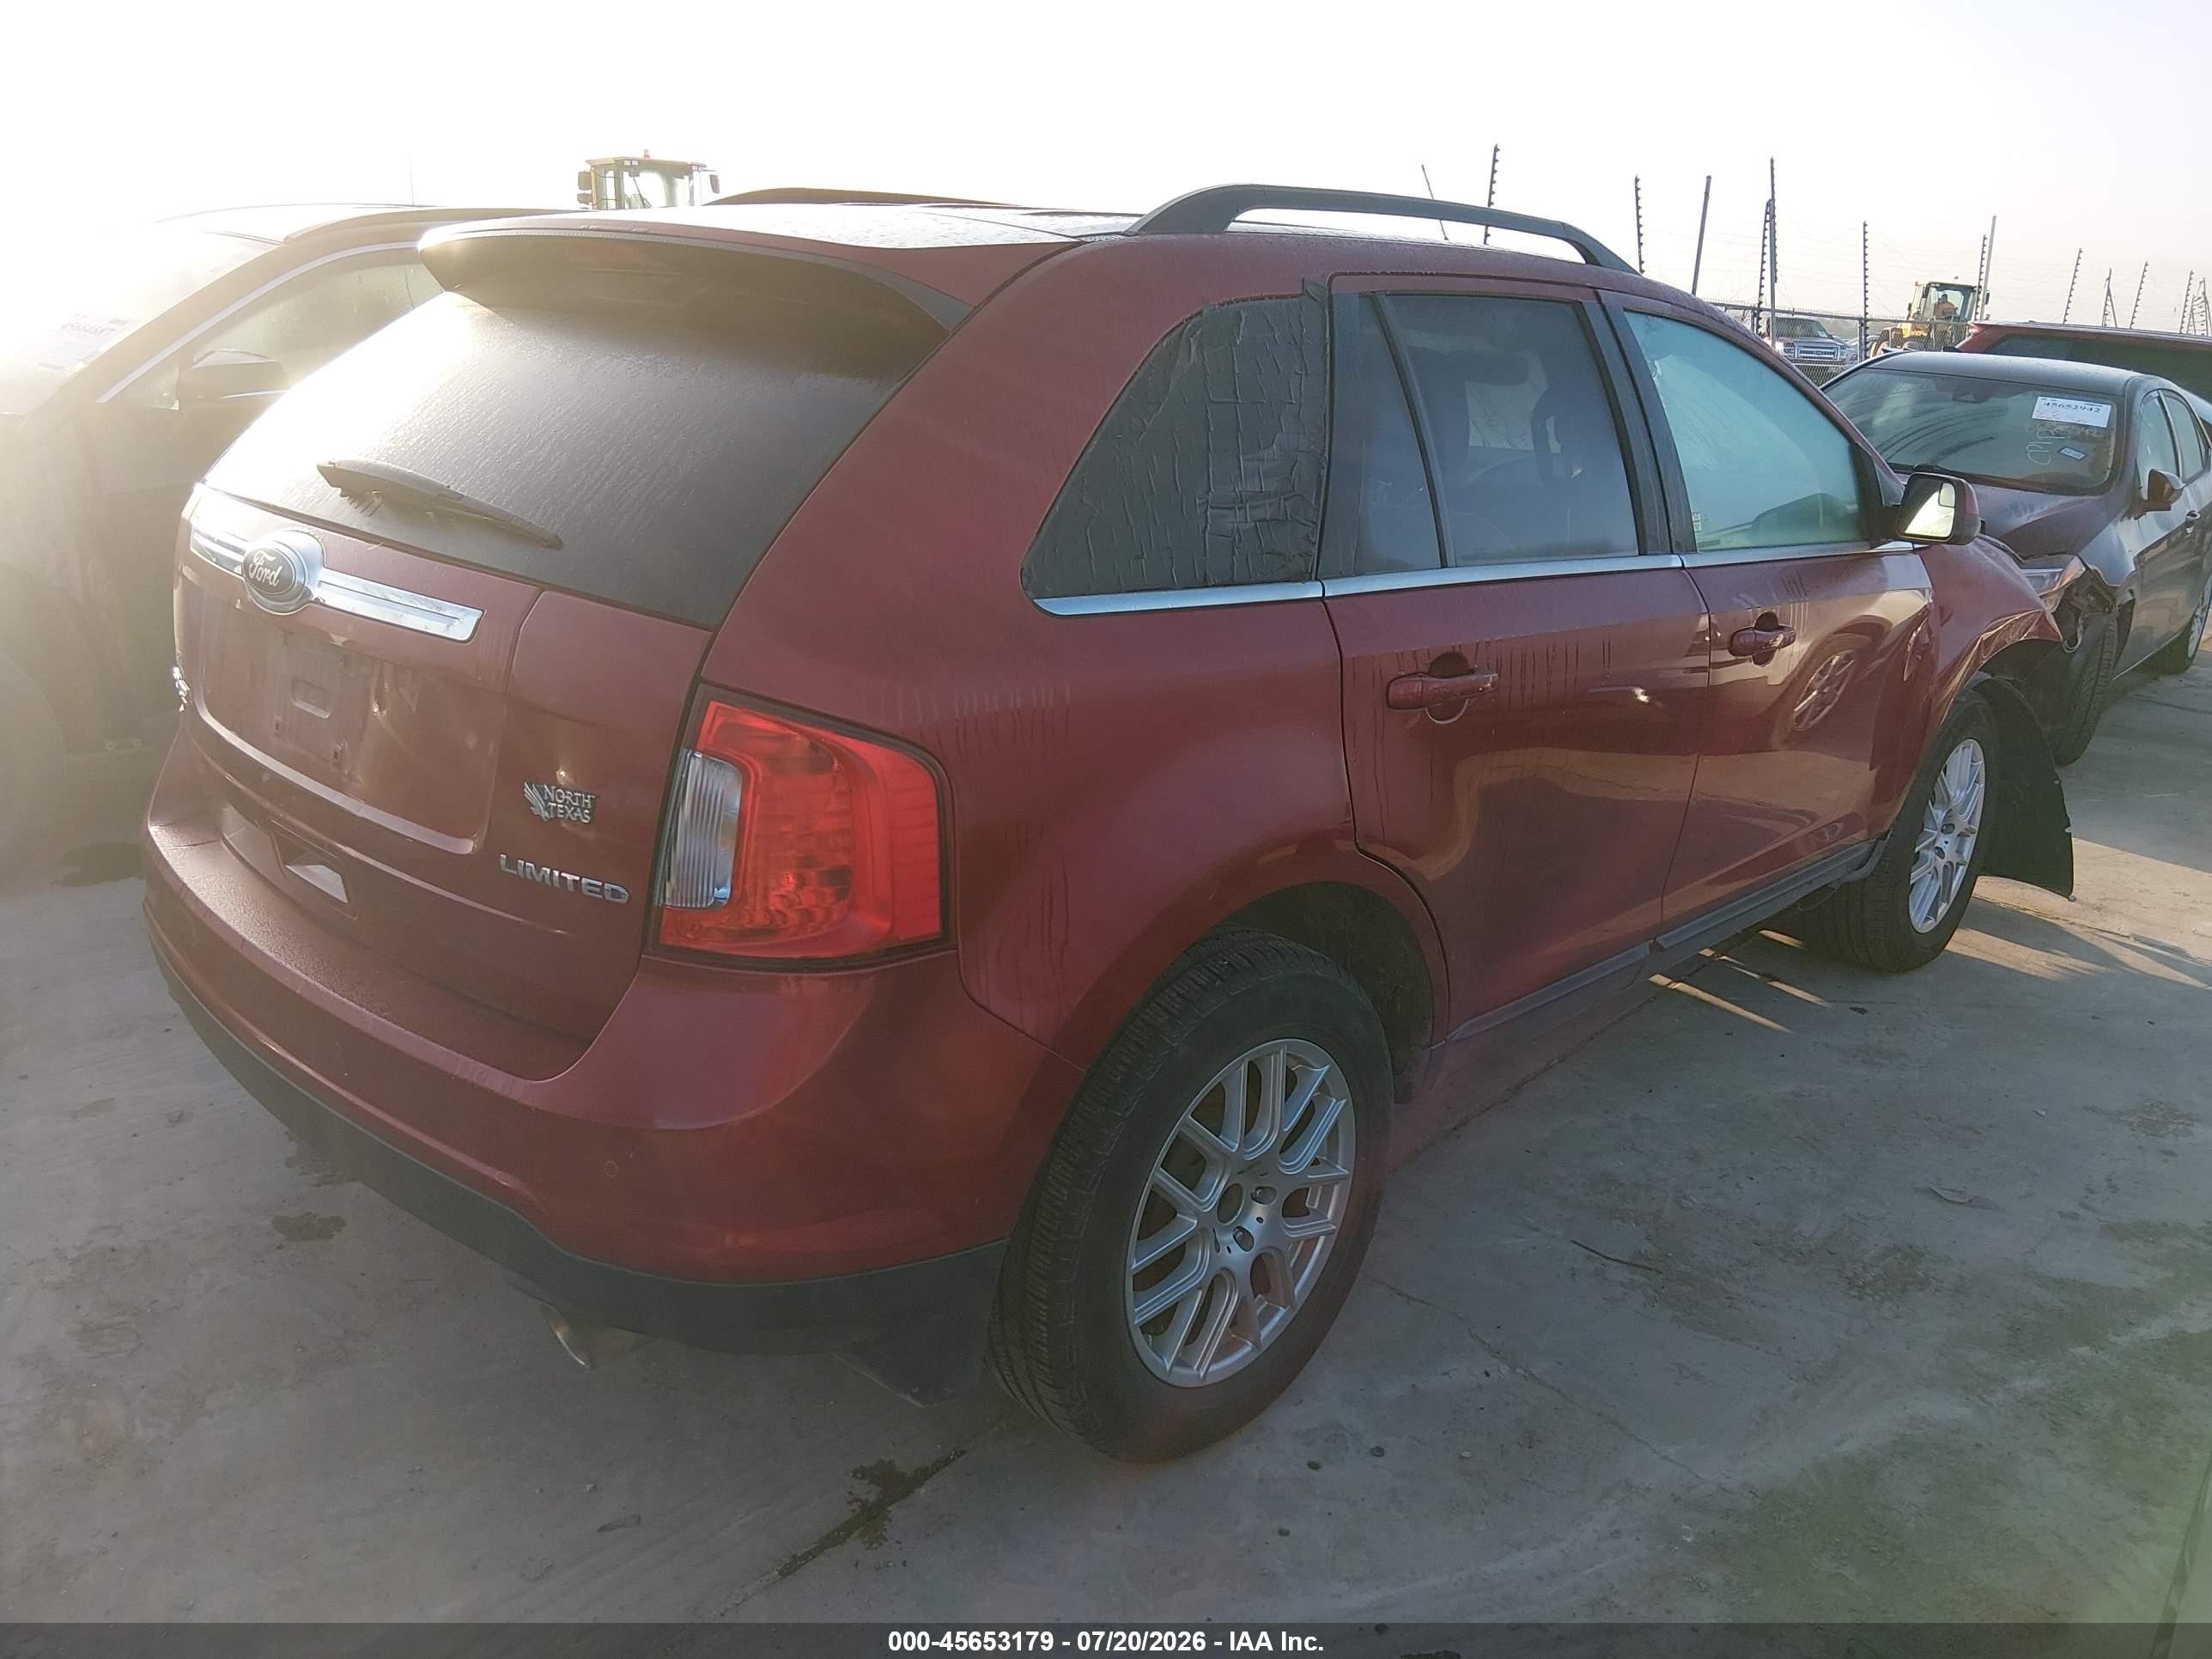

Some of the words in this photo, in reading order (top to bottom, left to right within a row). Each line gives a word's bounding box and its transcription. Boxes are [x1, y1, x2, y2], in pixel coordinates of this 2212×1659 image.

[248, 550, 283, 587] Ford
[544, 784, 594, 809] NORTH
[547, 802, 592, 823] TEXAS
[500, 854, 629, 904] LIMITED
